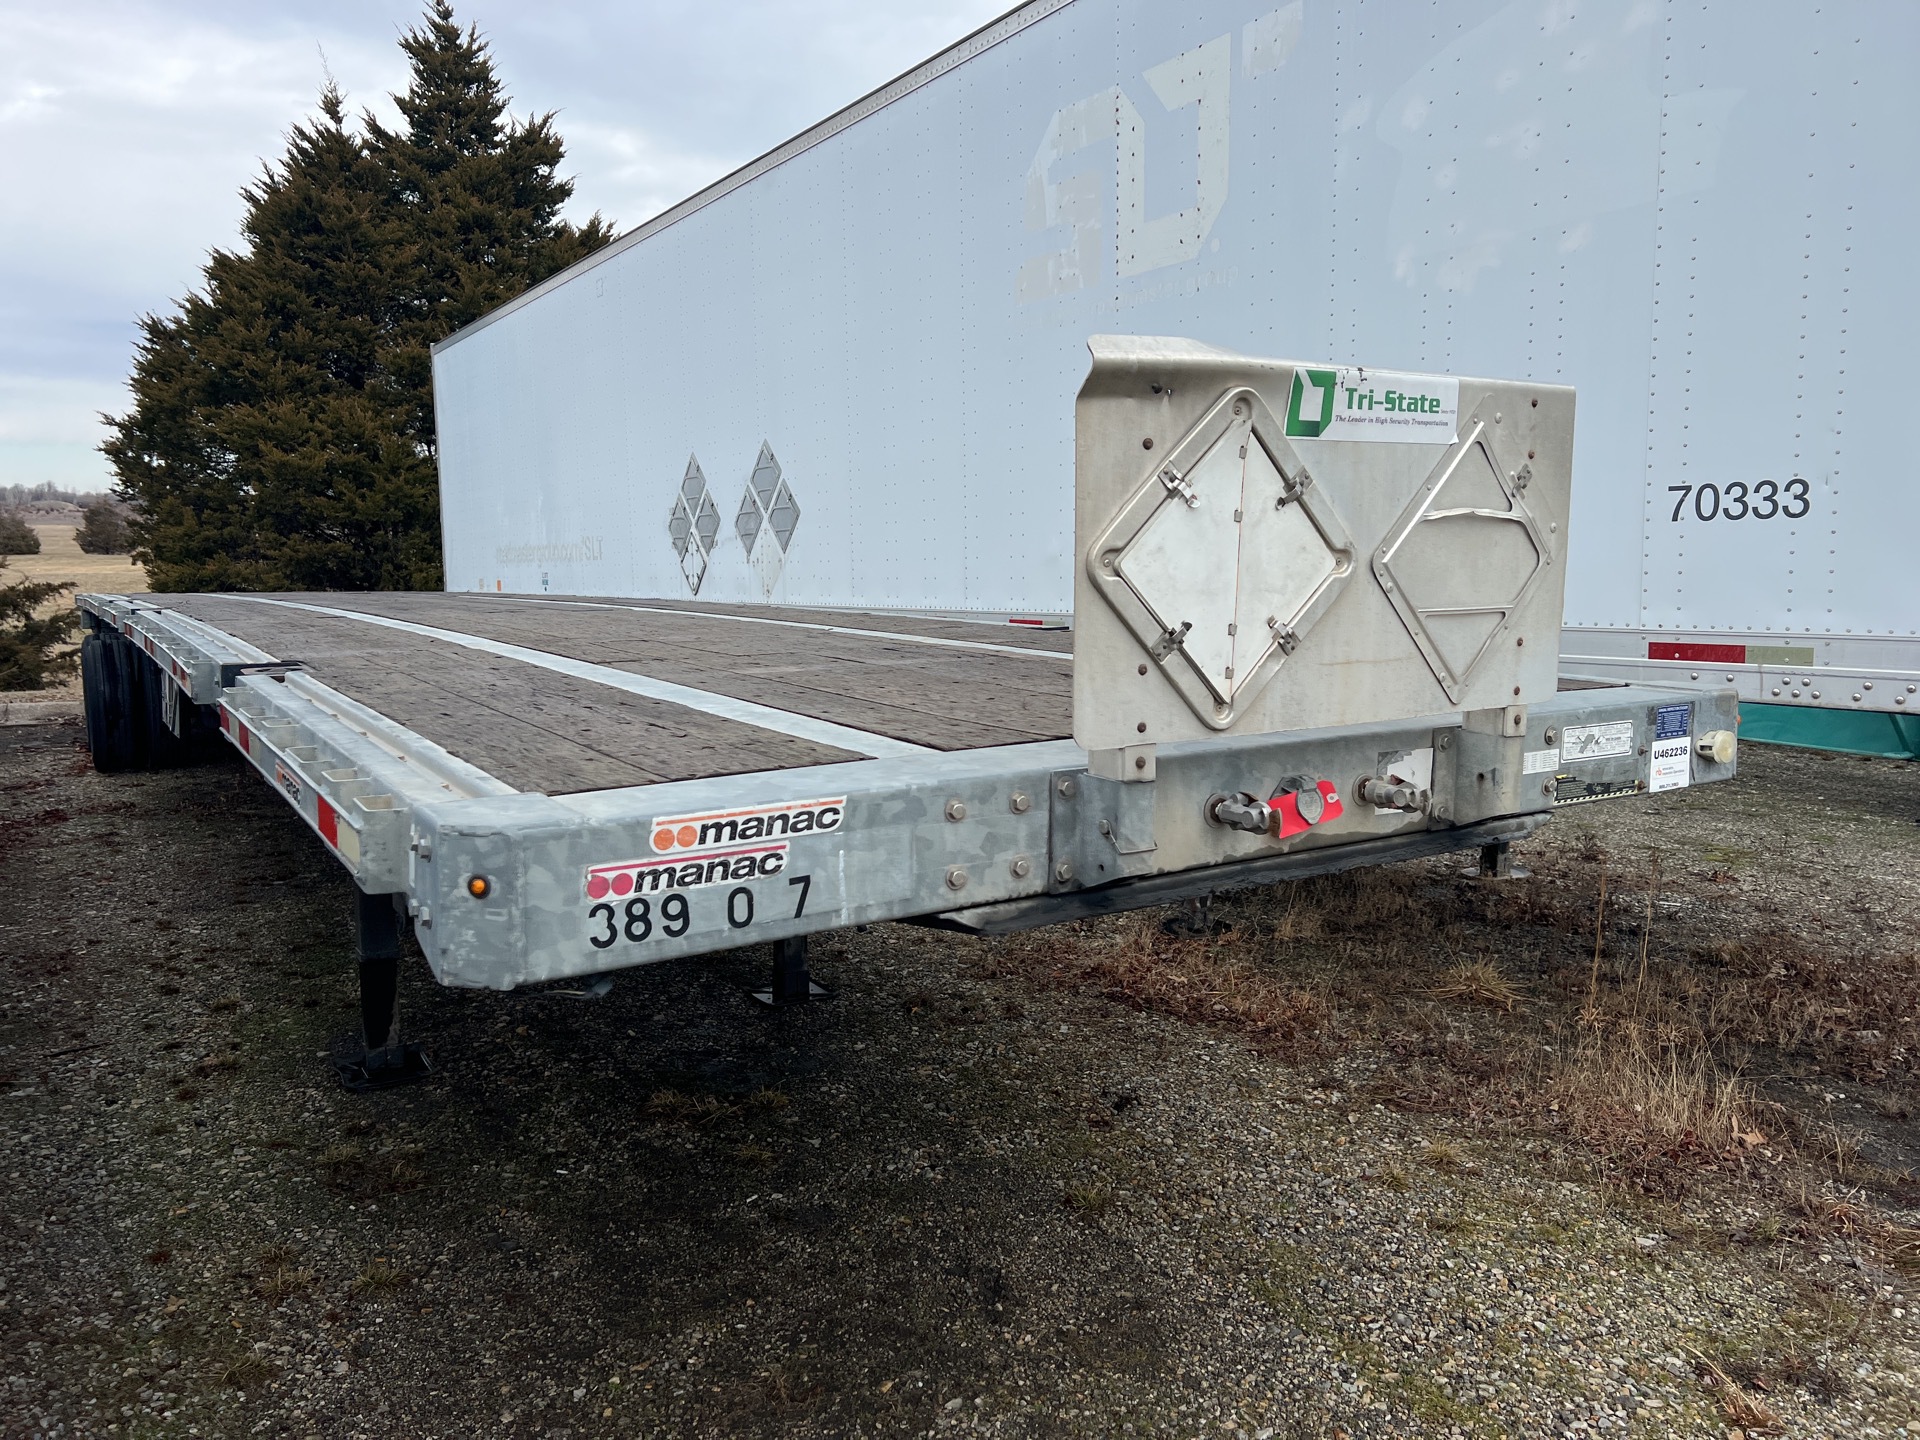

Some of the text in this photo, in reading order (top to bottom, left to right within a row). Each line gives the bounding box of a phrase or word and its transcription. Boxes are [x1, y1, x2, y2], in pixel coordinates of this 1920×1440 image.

[1345, 387, 1441, 414] Tri-State
[1347, 415, 1367, 423] Leader
[1375, 417, 1388, 425] High
[1389, 418, 1410, 426] Security
[1411, 418, 1449, 427] Transportation
[1668, 478, 1811, 522] 70333
[1653, 745, 1688, 760] U462236
[697, 806, 841, 846] manac
[633, 851, 784, 894] manac
[588, 874, 811, 949] 389 0 7
